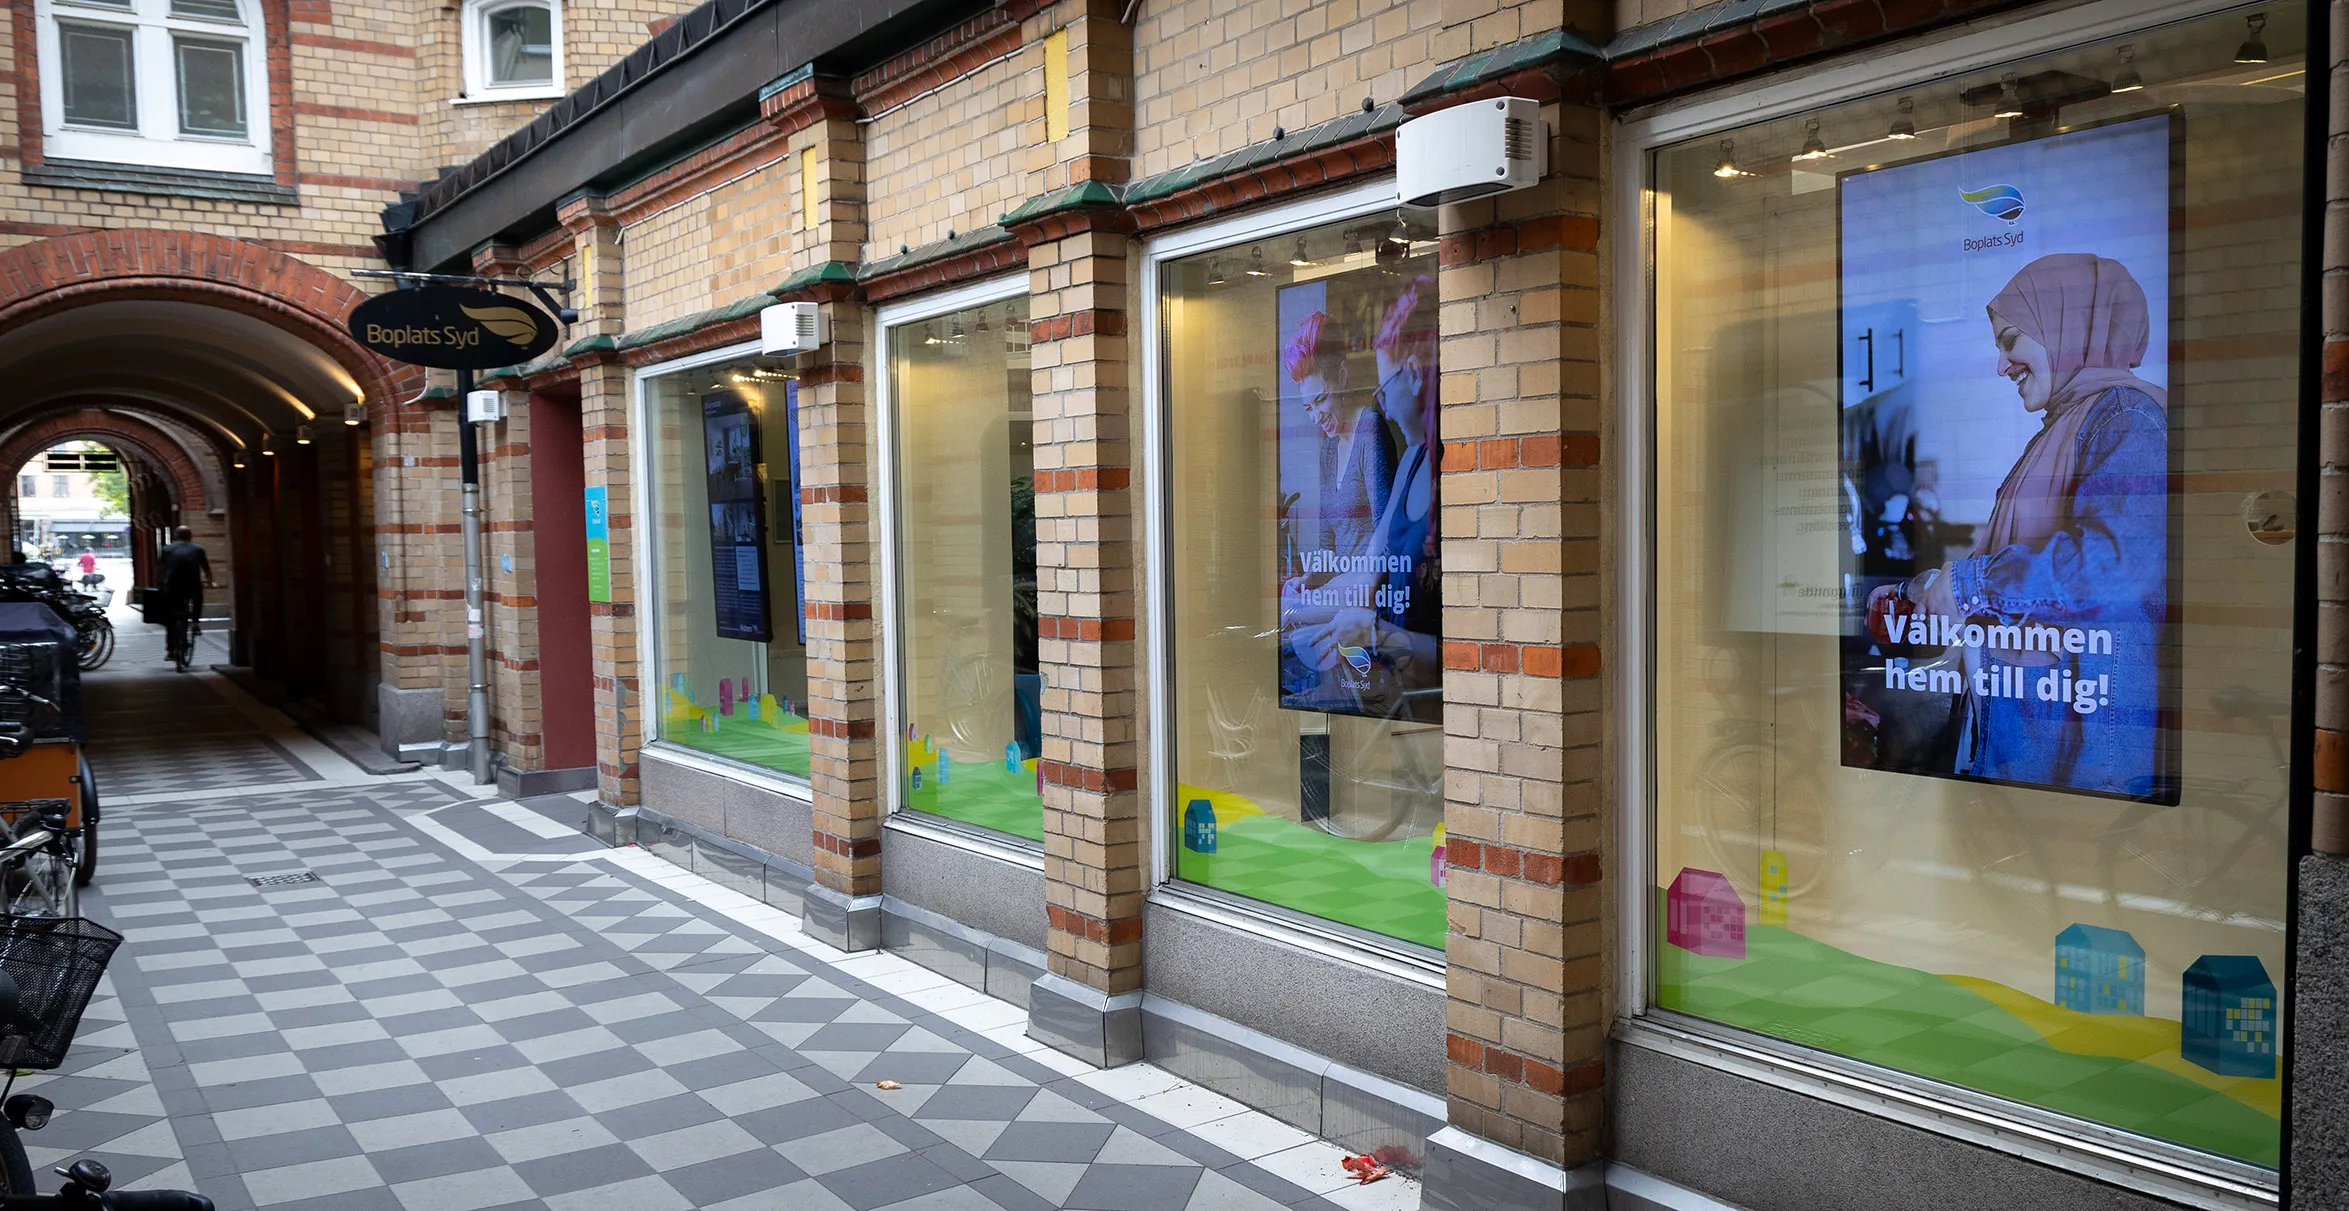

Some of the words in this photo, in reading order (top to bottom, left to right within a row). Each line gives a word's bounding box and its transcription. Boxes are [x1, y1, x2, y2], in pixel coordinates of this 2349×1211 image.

[1963, 236, 2003, 252] Boplats
[2003, 231, 2024, 247] Syd
[366, 323, 441, 348] Boplats
[444, 325, 480, 350] Syd
[1300, 549, 1412, 573] Välkommen
[1300, 583, 1340, 607] hem
[1344, 583, 1370, 607] till
[1375, 584, 1411, 615] dig!
[1883, 613, 2112, 655] Välkommen
[1360, 680, 1371, 691] Syd
[1885, 658, 1962, 694] hem
[1973, 664, 2024, 699] till
[2036, 668, 2109, 714] dig!
